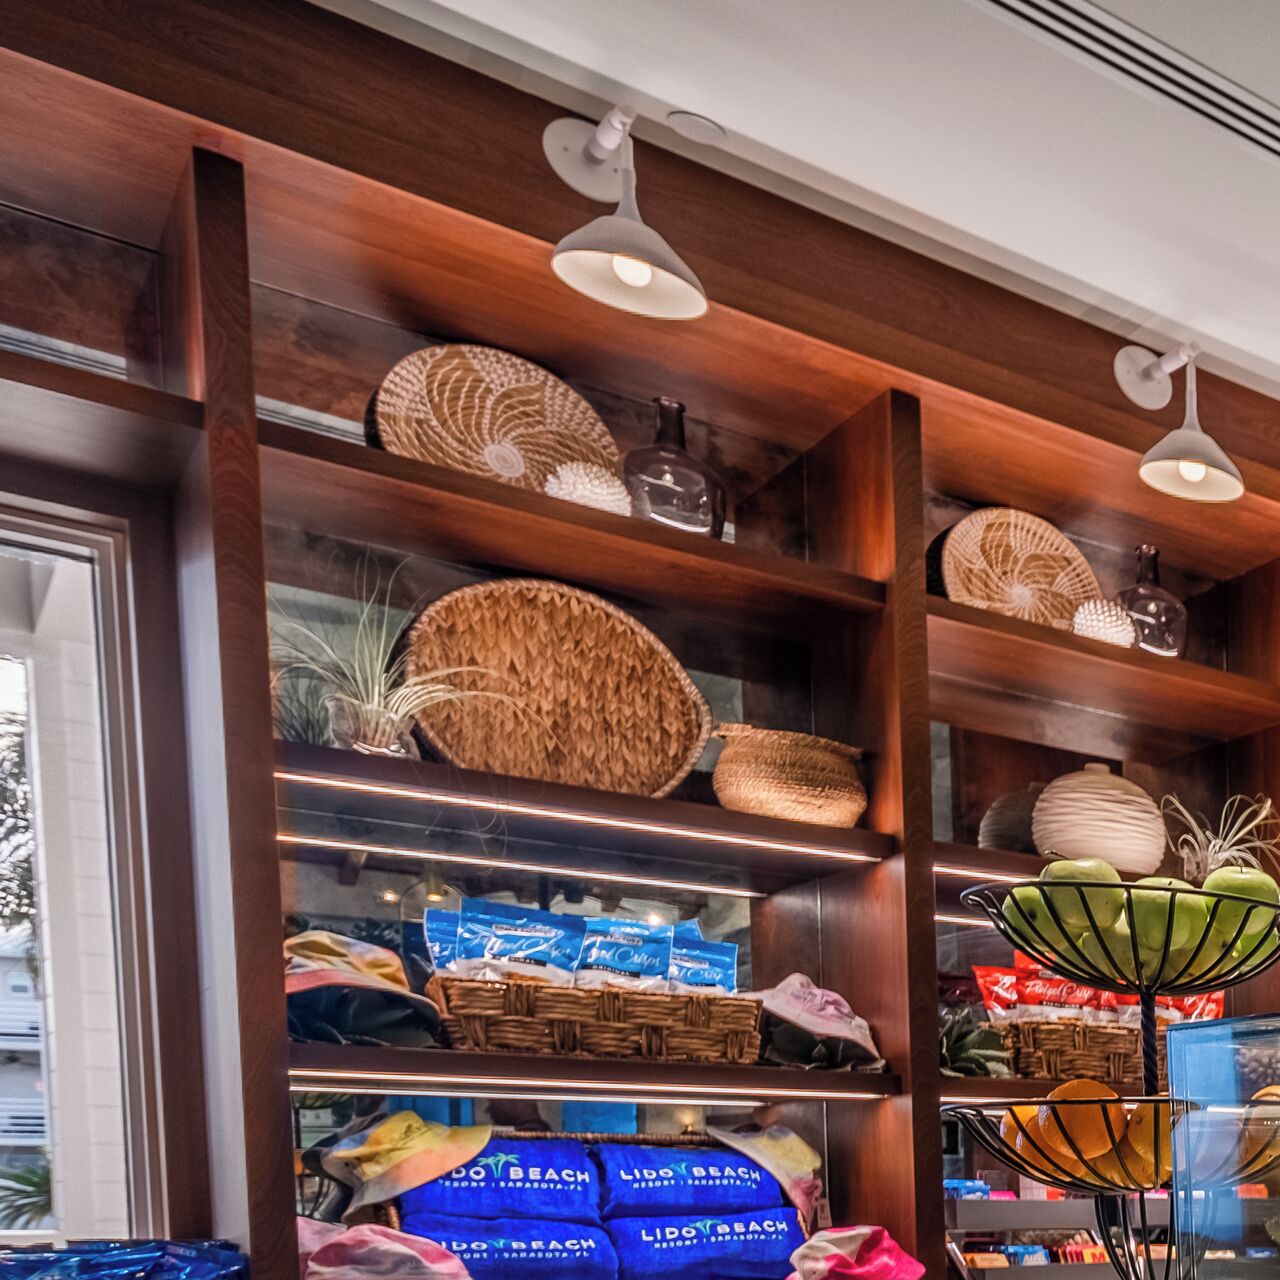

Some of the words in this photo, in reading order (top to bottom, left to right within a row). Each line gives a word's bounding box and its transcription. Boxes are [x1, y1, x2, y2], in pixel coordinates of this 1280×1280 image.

[510, 1166, 590, 1184] BEACH
[619, 1168, 674, 1181] LIDO
[692, 1166, 761, 1182] BEACH
[641, 1226, 697, 1242] LIDO
[716, 1220, 789, 1235] BEACH
[511, 1238, 596, 1251] BEACH
